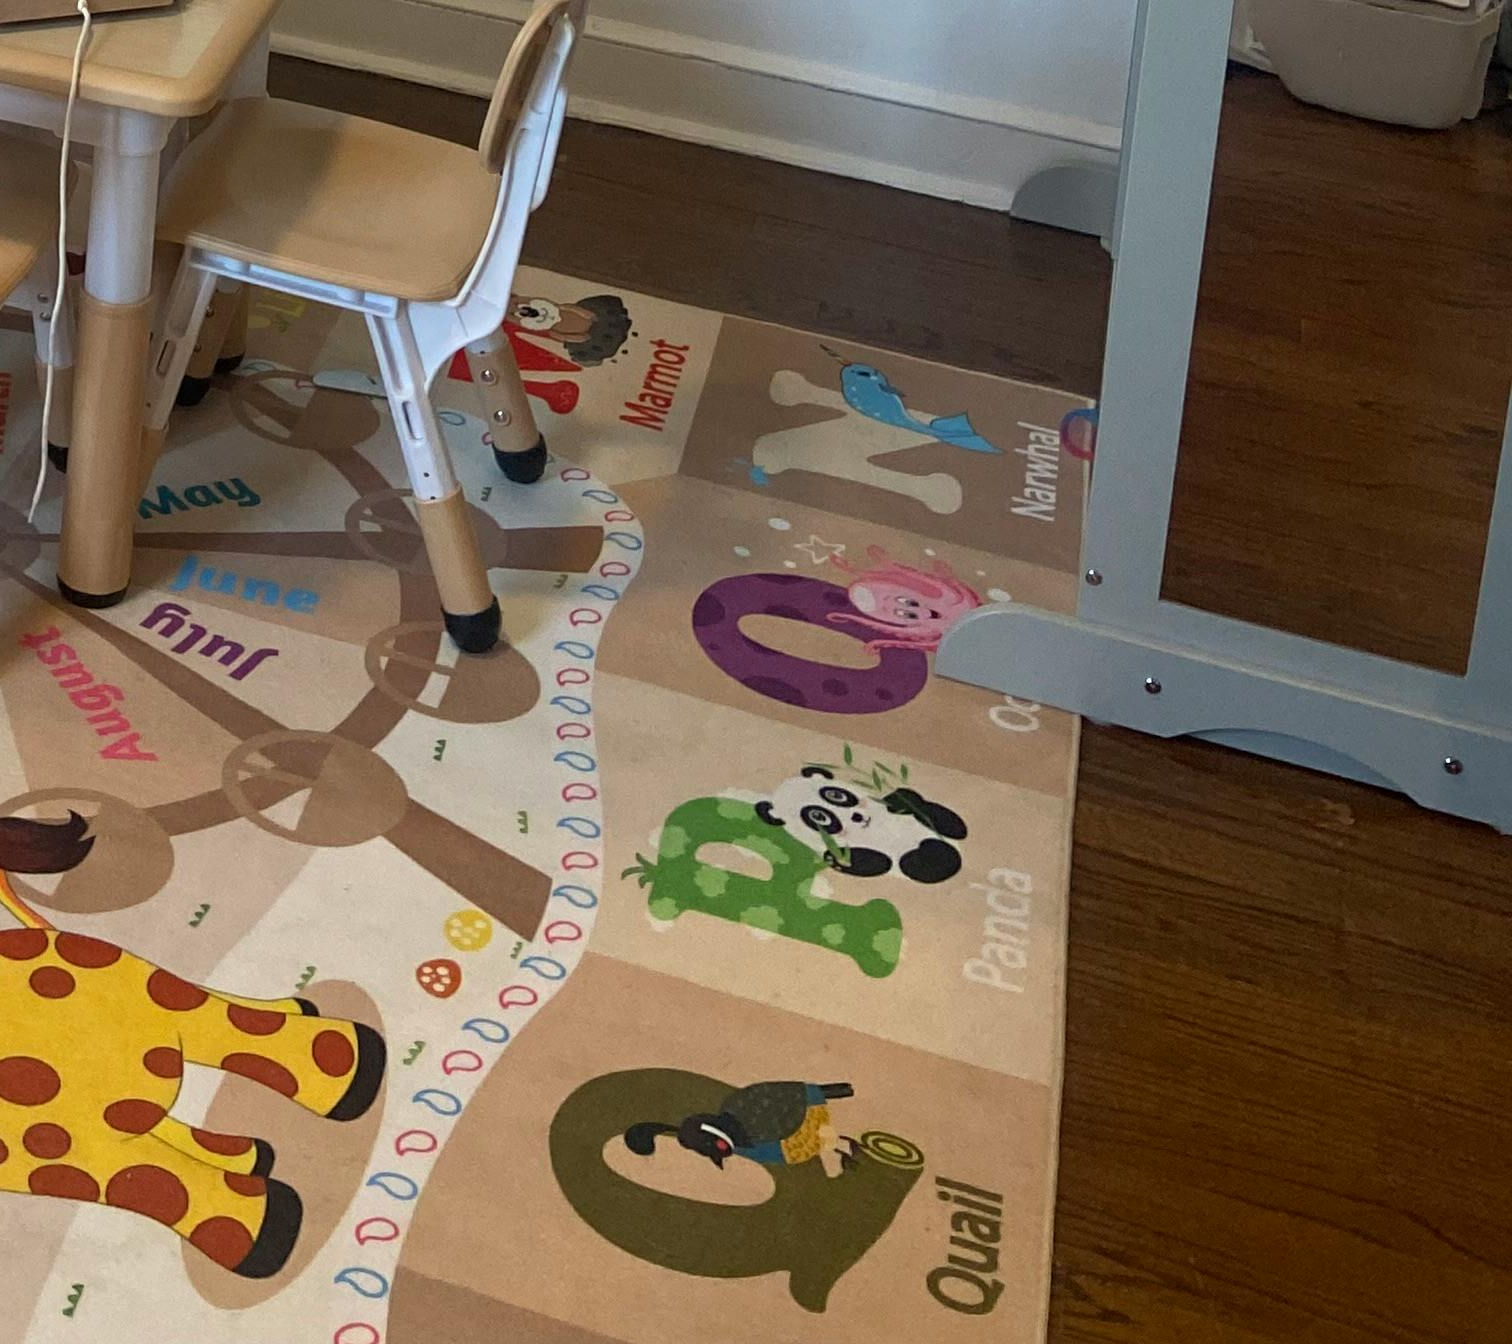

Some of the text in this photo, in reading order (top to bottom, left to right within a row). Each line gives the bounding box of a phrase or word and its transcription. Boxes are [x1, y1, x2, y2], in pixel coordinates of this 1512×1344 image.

[619, 339, 690, 431] Marmot
[136, 474, 262, 519] May
[1011, 421, 1062, 523] Narwhal
[173, 555, 319, 616] June
[140, 603, 281, 681] July
[20, 624, 160, 763] August
[963, 866, 1032, 992] Panda
[926, 1176, 1004, 1316] Quail
